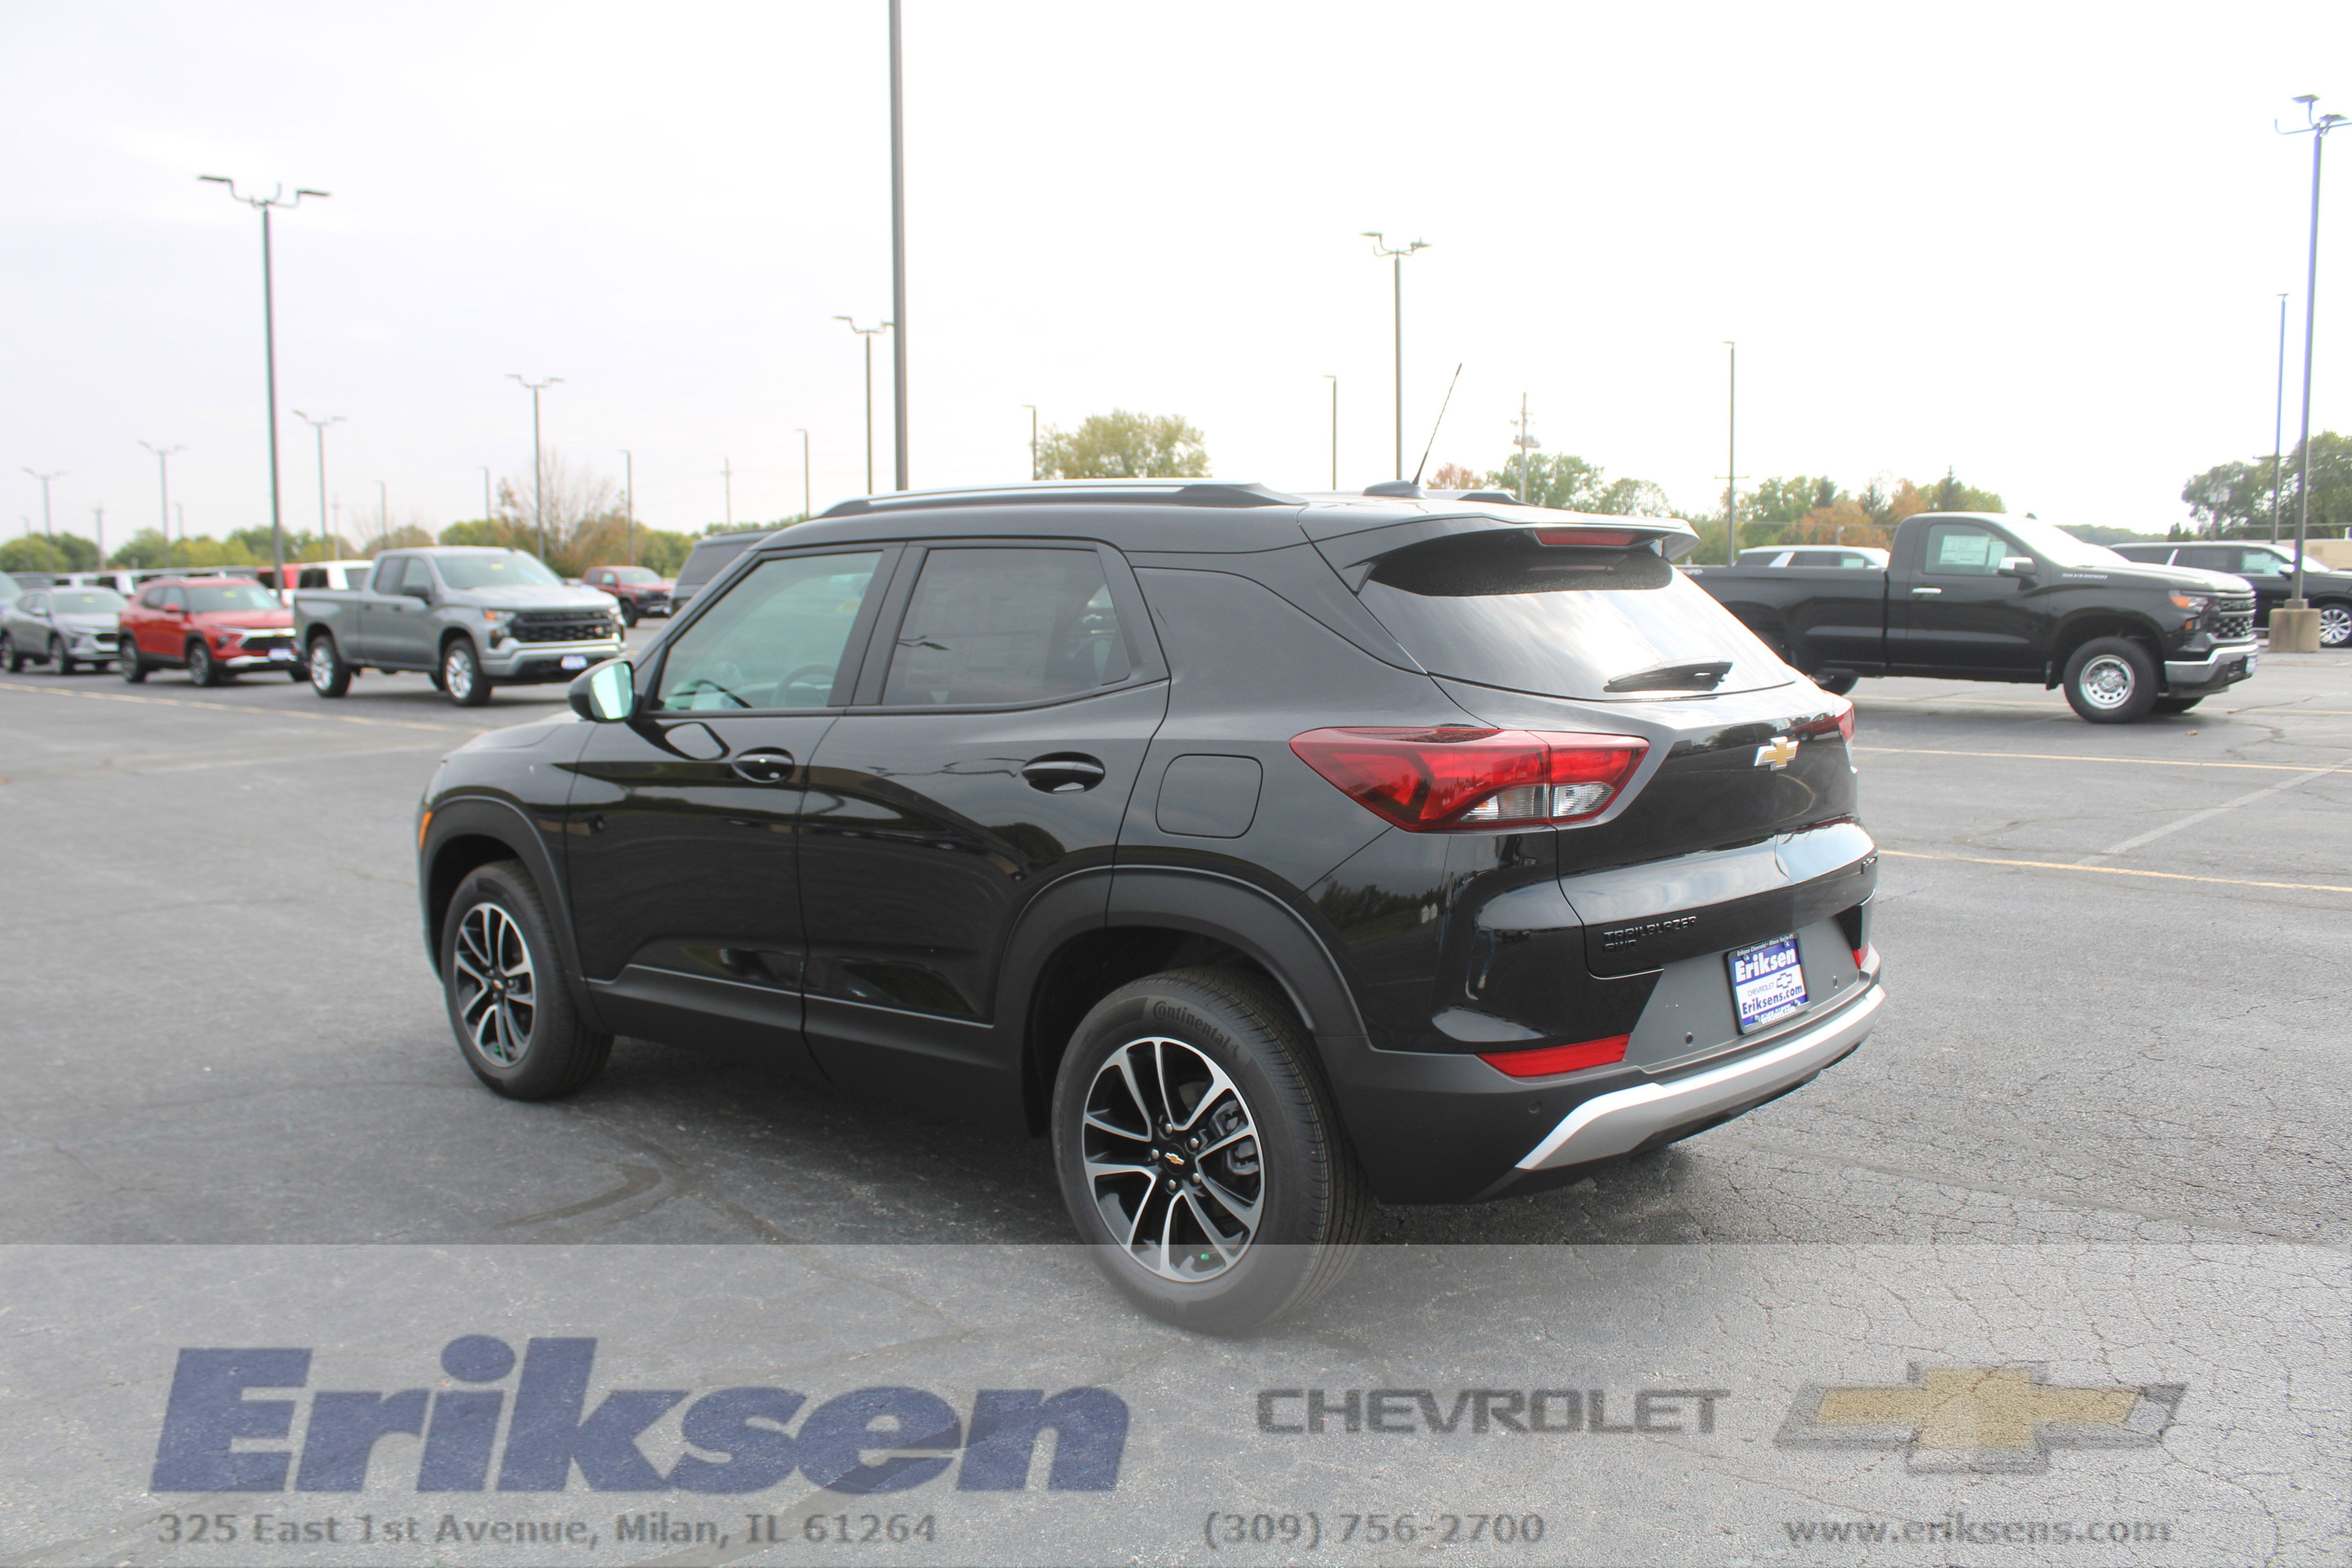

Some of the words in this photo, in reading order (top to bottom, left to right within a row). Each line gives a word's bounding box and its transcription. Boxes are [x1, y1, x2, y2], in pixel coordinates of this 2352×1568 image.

[1603, 916, 1697, 940] TRAILBLAZER
[1737, 949, 1751, 957] Eriksen
[1751, 942, 1767, 952] Chevrolet
[1735, 948, 1796, 983] Eriksen
[1742, 984, 1803, 1015] Eriksens.com
[1747, 982, 1774, 996] CHEVROLET
[1153, 1000, 1232, 1049] Continental
[1761, 1005, 1797, 1025] eriksens.com
